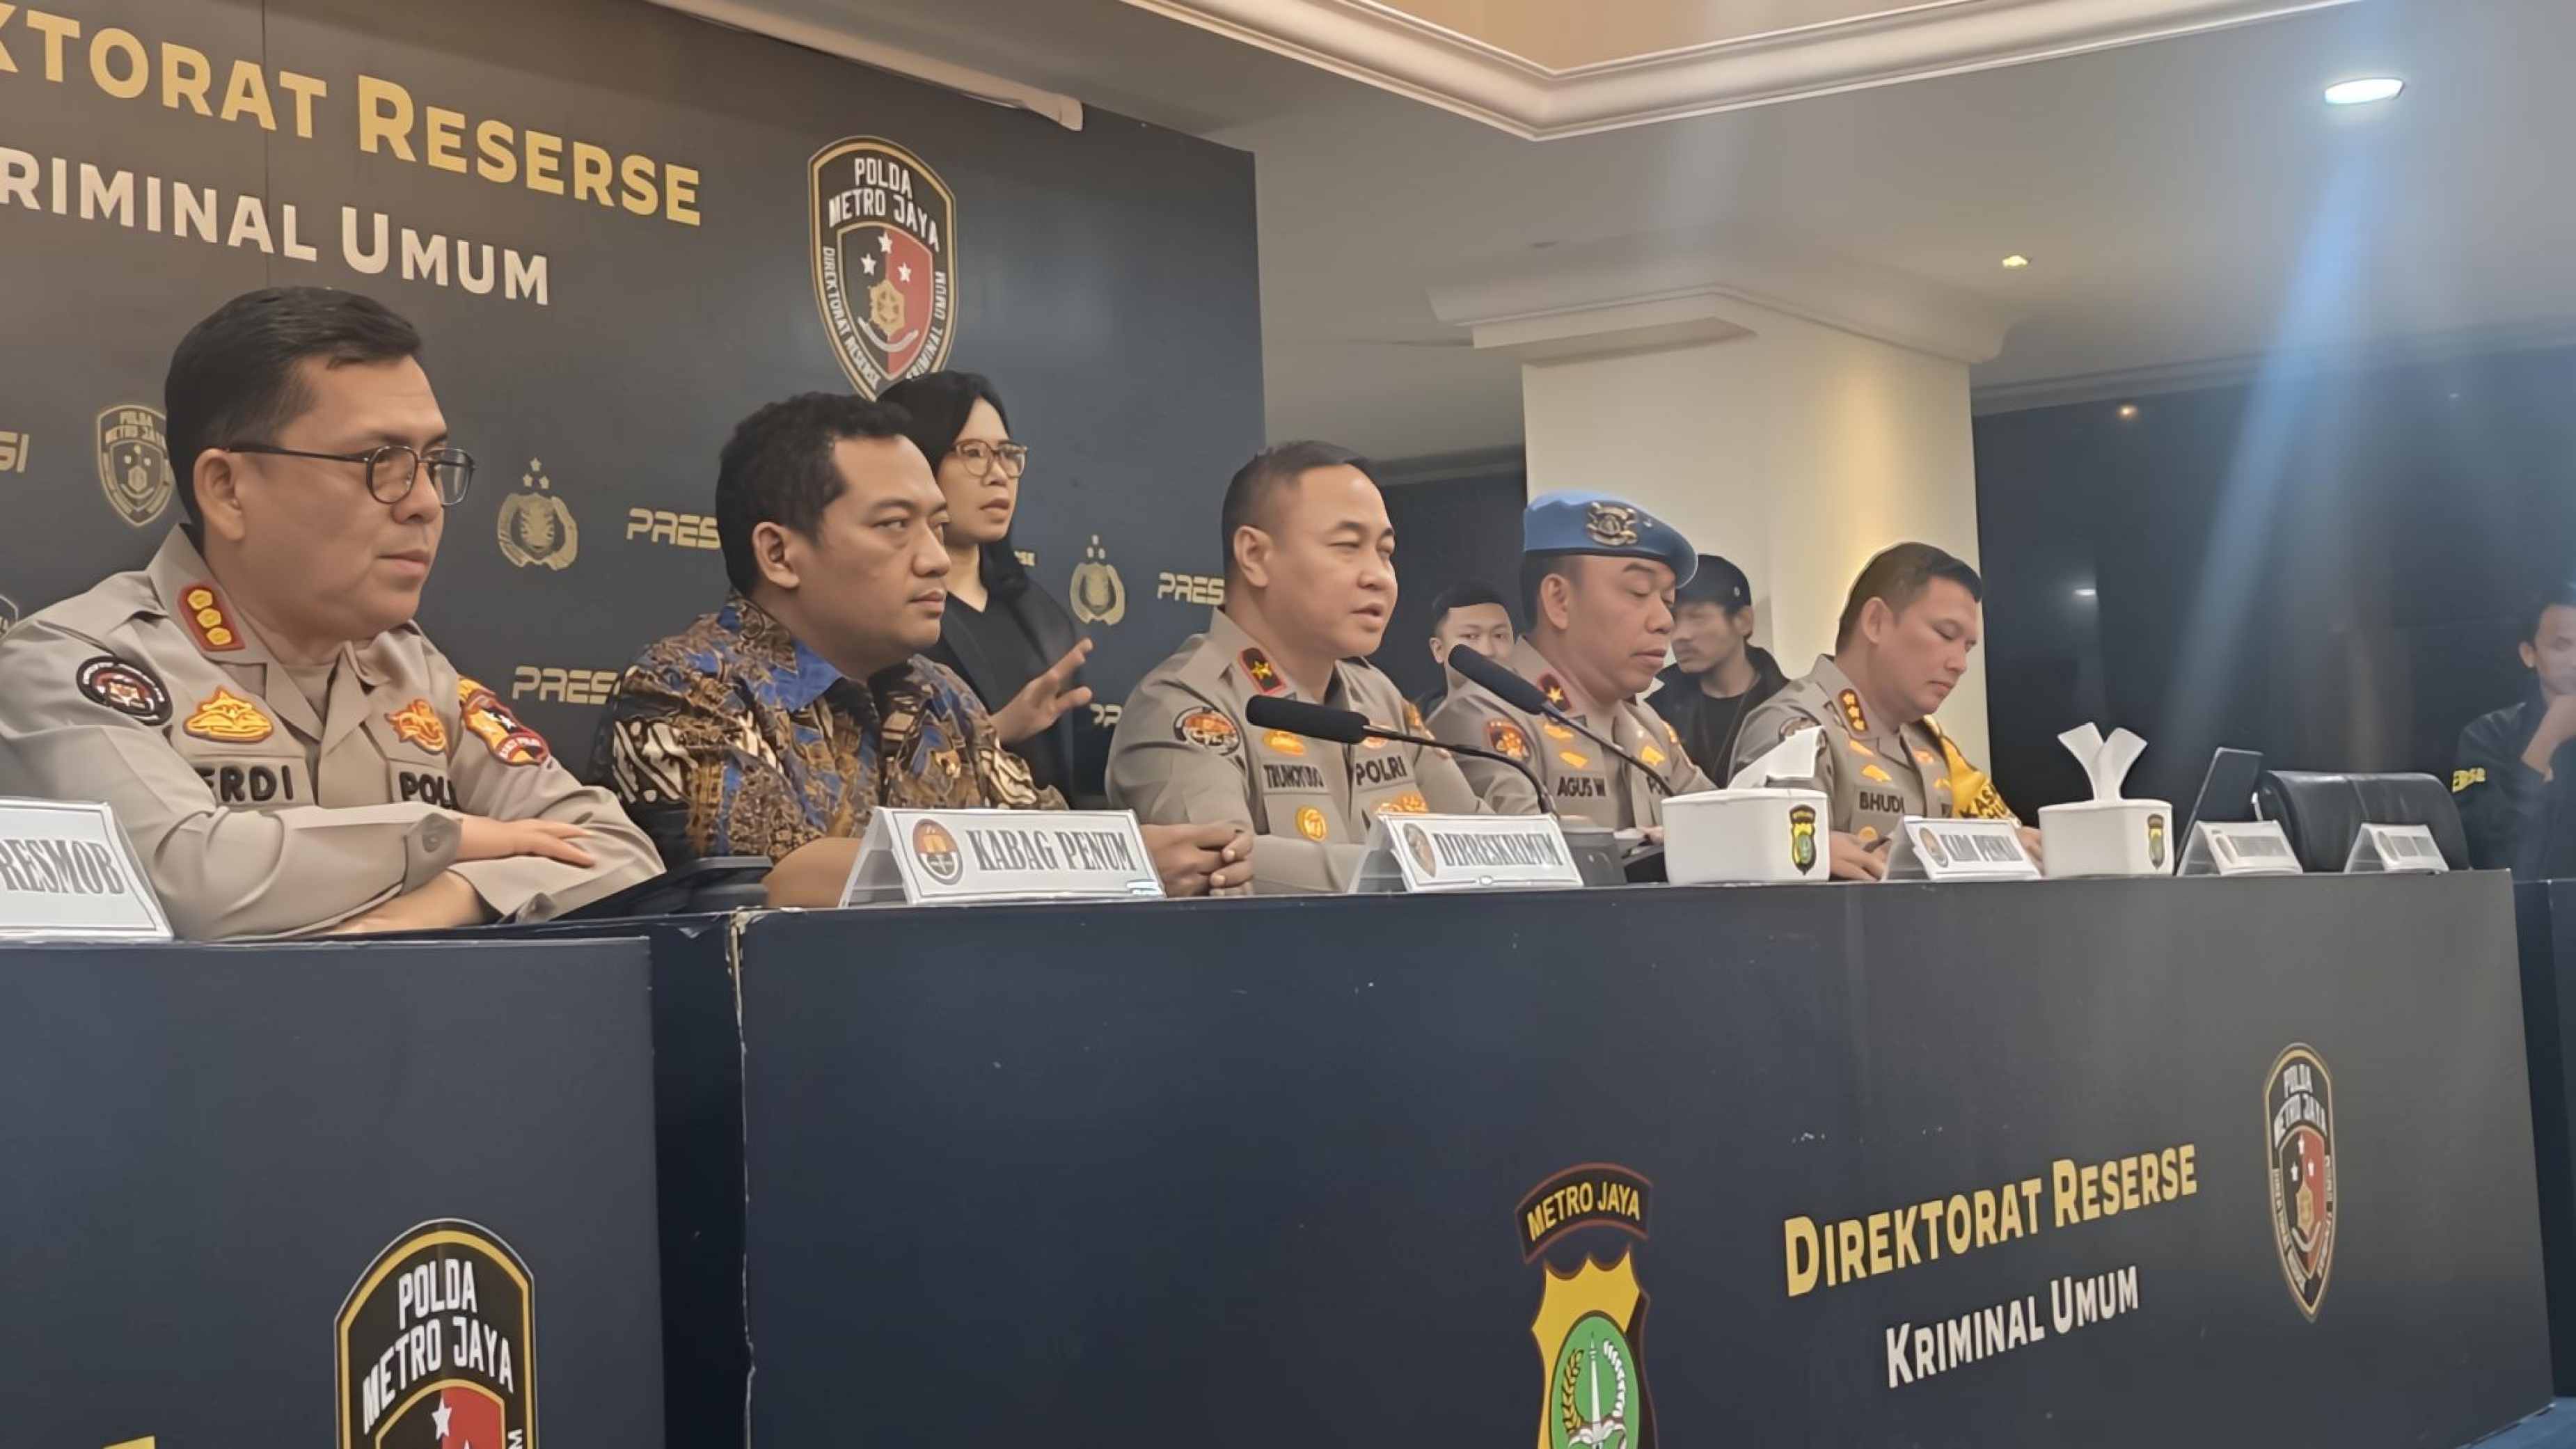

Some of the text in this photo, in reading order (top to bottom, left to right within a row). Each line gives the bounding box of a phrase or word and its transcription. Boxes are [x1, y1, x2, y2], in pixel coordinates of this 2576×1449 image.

[357, 74, 700, 225] RESERSE
[854, 157, 913, 200] POLDA
[828, 187, 940, 253] METRO JAYA
[341, 206, 548, 305] UMUM
[1157, 571, 1225, 605] PRES
[1355, 755, 1408, 786] POLRI
[1557, 775, 1593, 797] AGUS
[965, 830, 1138, 871] KABAG PENUM
[1526, 1181, 1641, 1241] METRO JAYA
[1783, 1178, 2043, 1297] DIREKTORAT
[2052, 1143, 2198, 1228] RESERSE
[398, 1258, 477, 1331] POLDA
[1886, 1265, 2140, 1389] KRIMINAL UMUM
[362, 1315, 514, 1436] METRO JAYA
